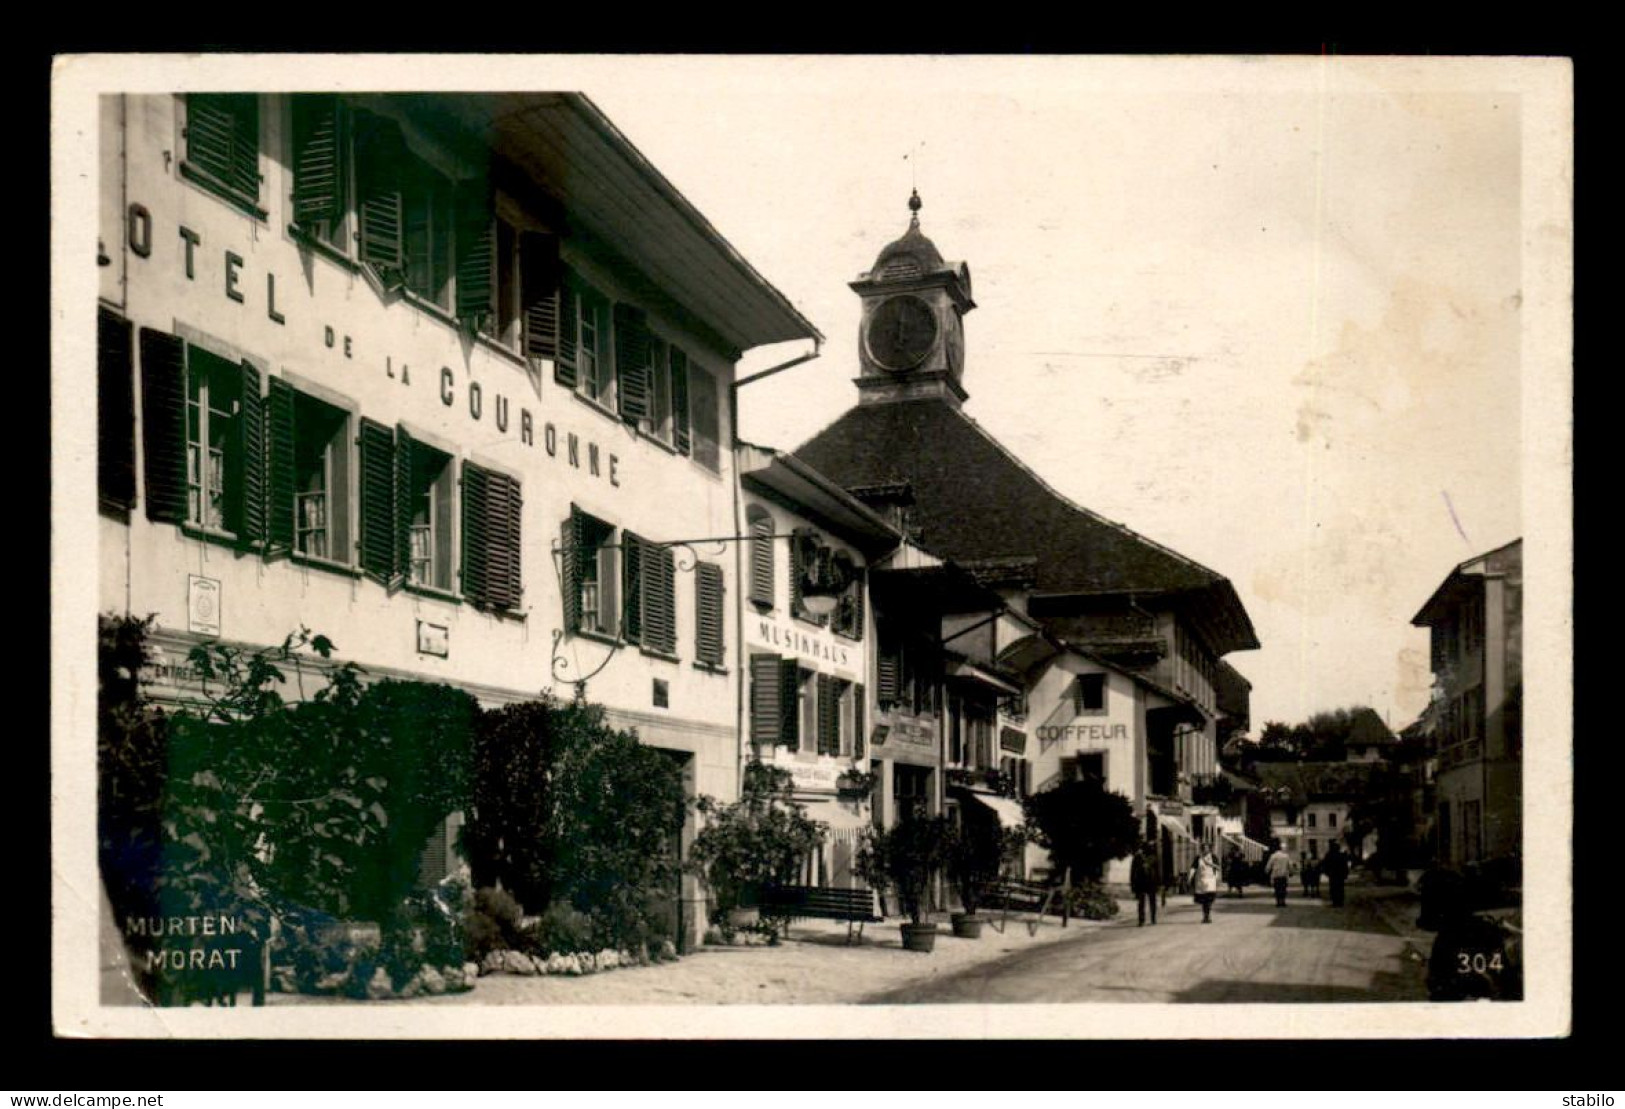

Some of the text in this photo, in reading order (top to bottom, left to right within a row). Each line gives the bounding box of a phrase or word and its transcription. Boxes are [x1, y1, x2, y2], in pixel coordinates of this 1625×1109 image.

[325, 324, 353, 359] DE
[387, 356, 411, 387] LA
[441, 366, 620, 488] COURONNE
[760, 621, 848, 665] MUSIKHAUS
[1036, 724, 1128, 741] COIFFEUR
